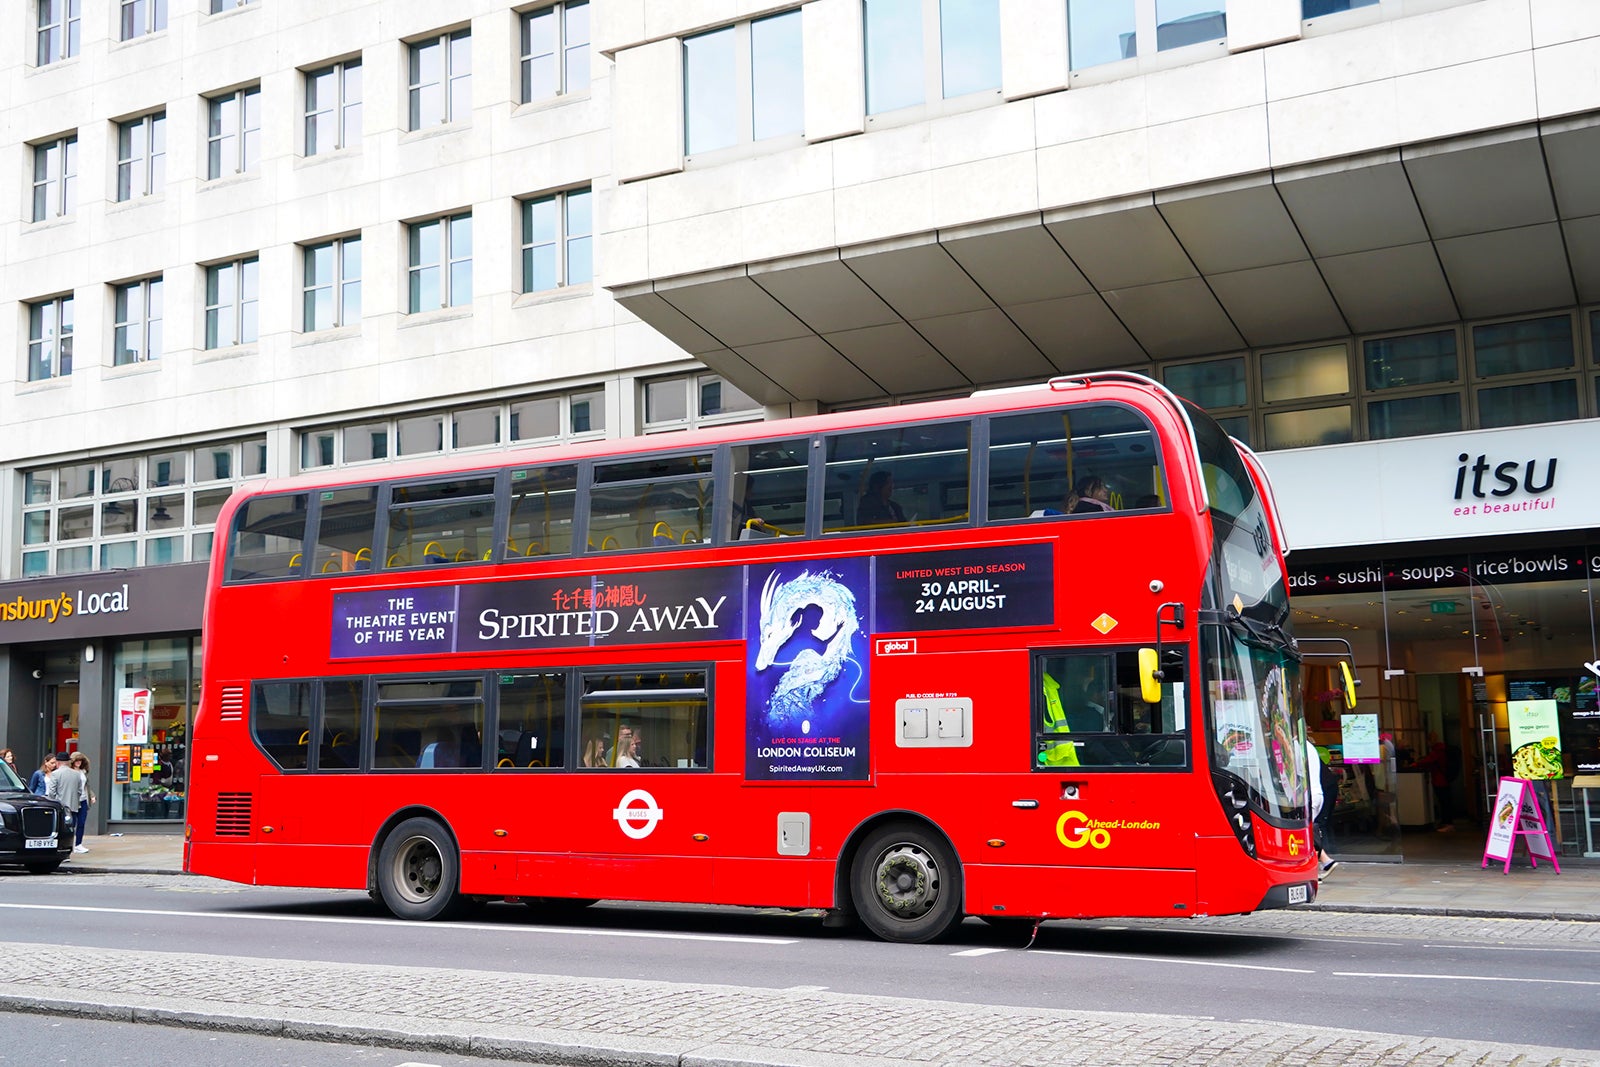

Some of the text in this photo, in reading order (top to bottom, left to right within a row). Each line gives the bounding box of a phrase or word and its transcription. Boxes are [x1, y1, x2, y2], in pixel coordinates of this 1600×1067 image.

[1454, 453, 1557, 500] itsu
[1453, 498, 1555, 516] eat beautiful
[896, 563, 1025, 579] LIMITED WEST END SEASON
[1337, 567, 1381, 584] sushi
[1401, 565, 1455, 582] soups
[921, 579, 1000, 596] 30 APRIL-
[0, 584, 129, 623] nsbury's Local
[388, 598, 414, 610] THE
[915, 595, 1006, 613] 24 AUGUST
[346, 611, 456, 629] THEATRE EVENT
[478, 595, 727, 640] SPIRITED AWAY
[354, 628, 445, 644] OF THE YEAR
[884, 642, 909, 654] global
[757, 747, 856, 758] LONDON COLISEUM
[769, 765, 843, 773] SpiritedAwayUK.com
[1056, 810, 1160, 849] Go Ahead-London
